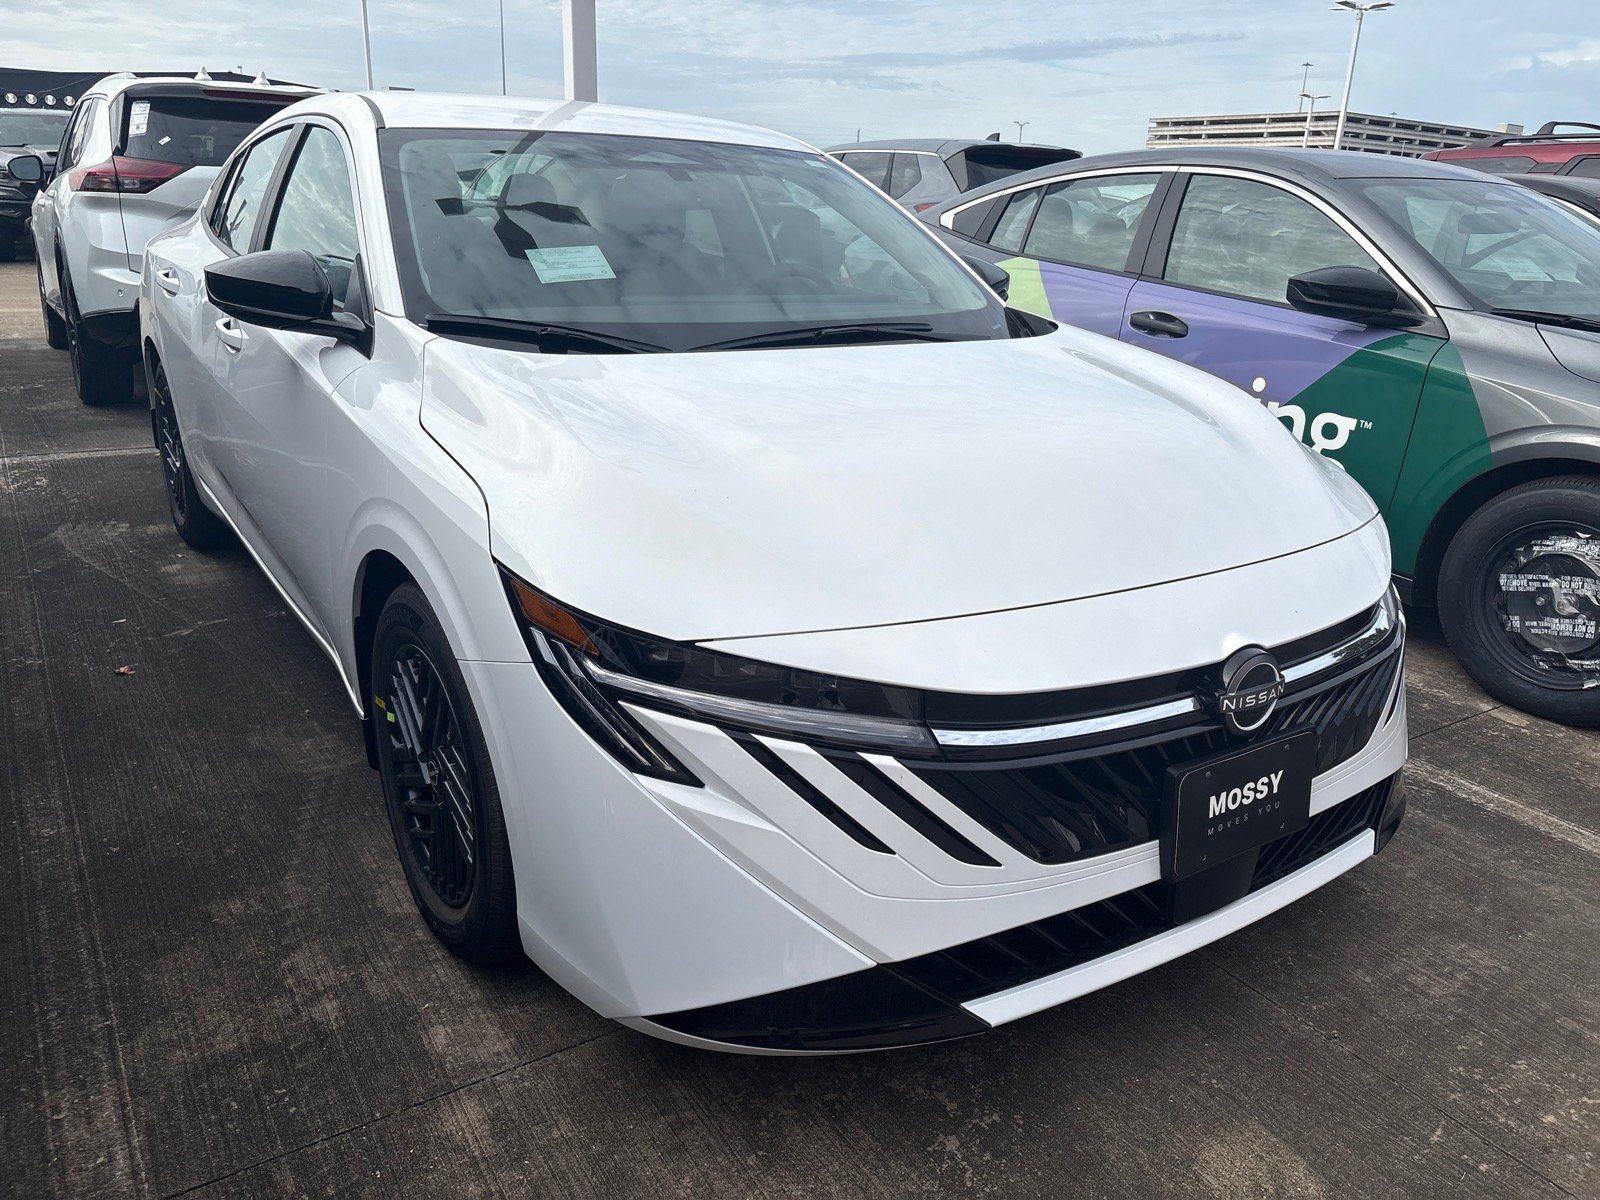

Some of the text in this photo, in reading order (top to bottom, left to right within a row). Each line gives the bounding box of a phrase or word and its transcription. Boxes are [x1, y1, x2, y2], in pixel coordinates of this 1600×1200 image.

[1222, 682, 1286, 711] NISSAN
[1208, 769, 1284, 819] MOSSY
[1207, 801, 1281, 837] MOVES YOU
